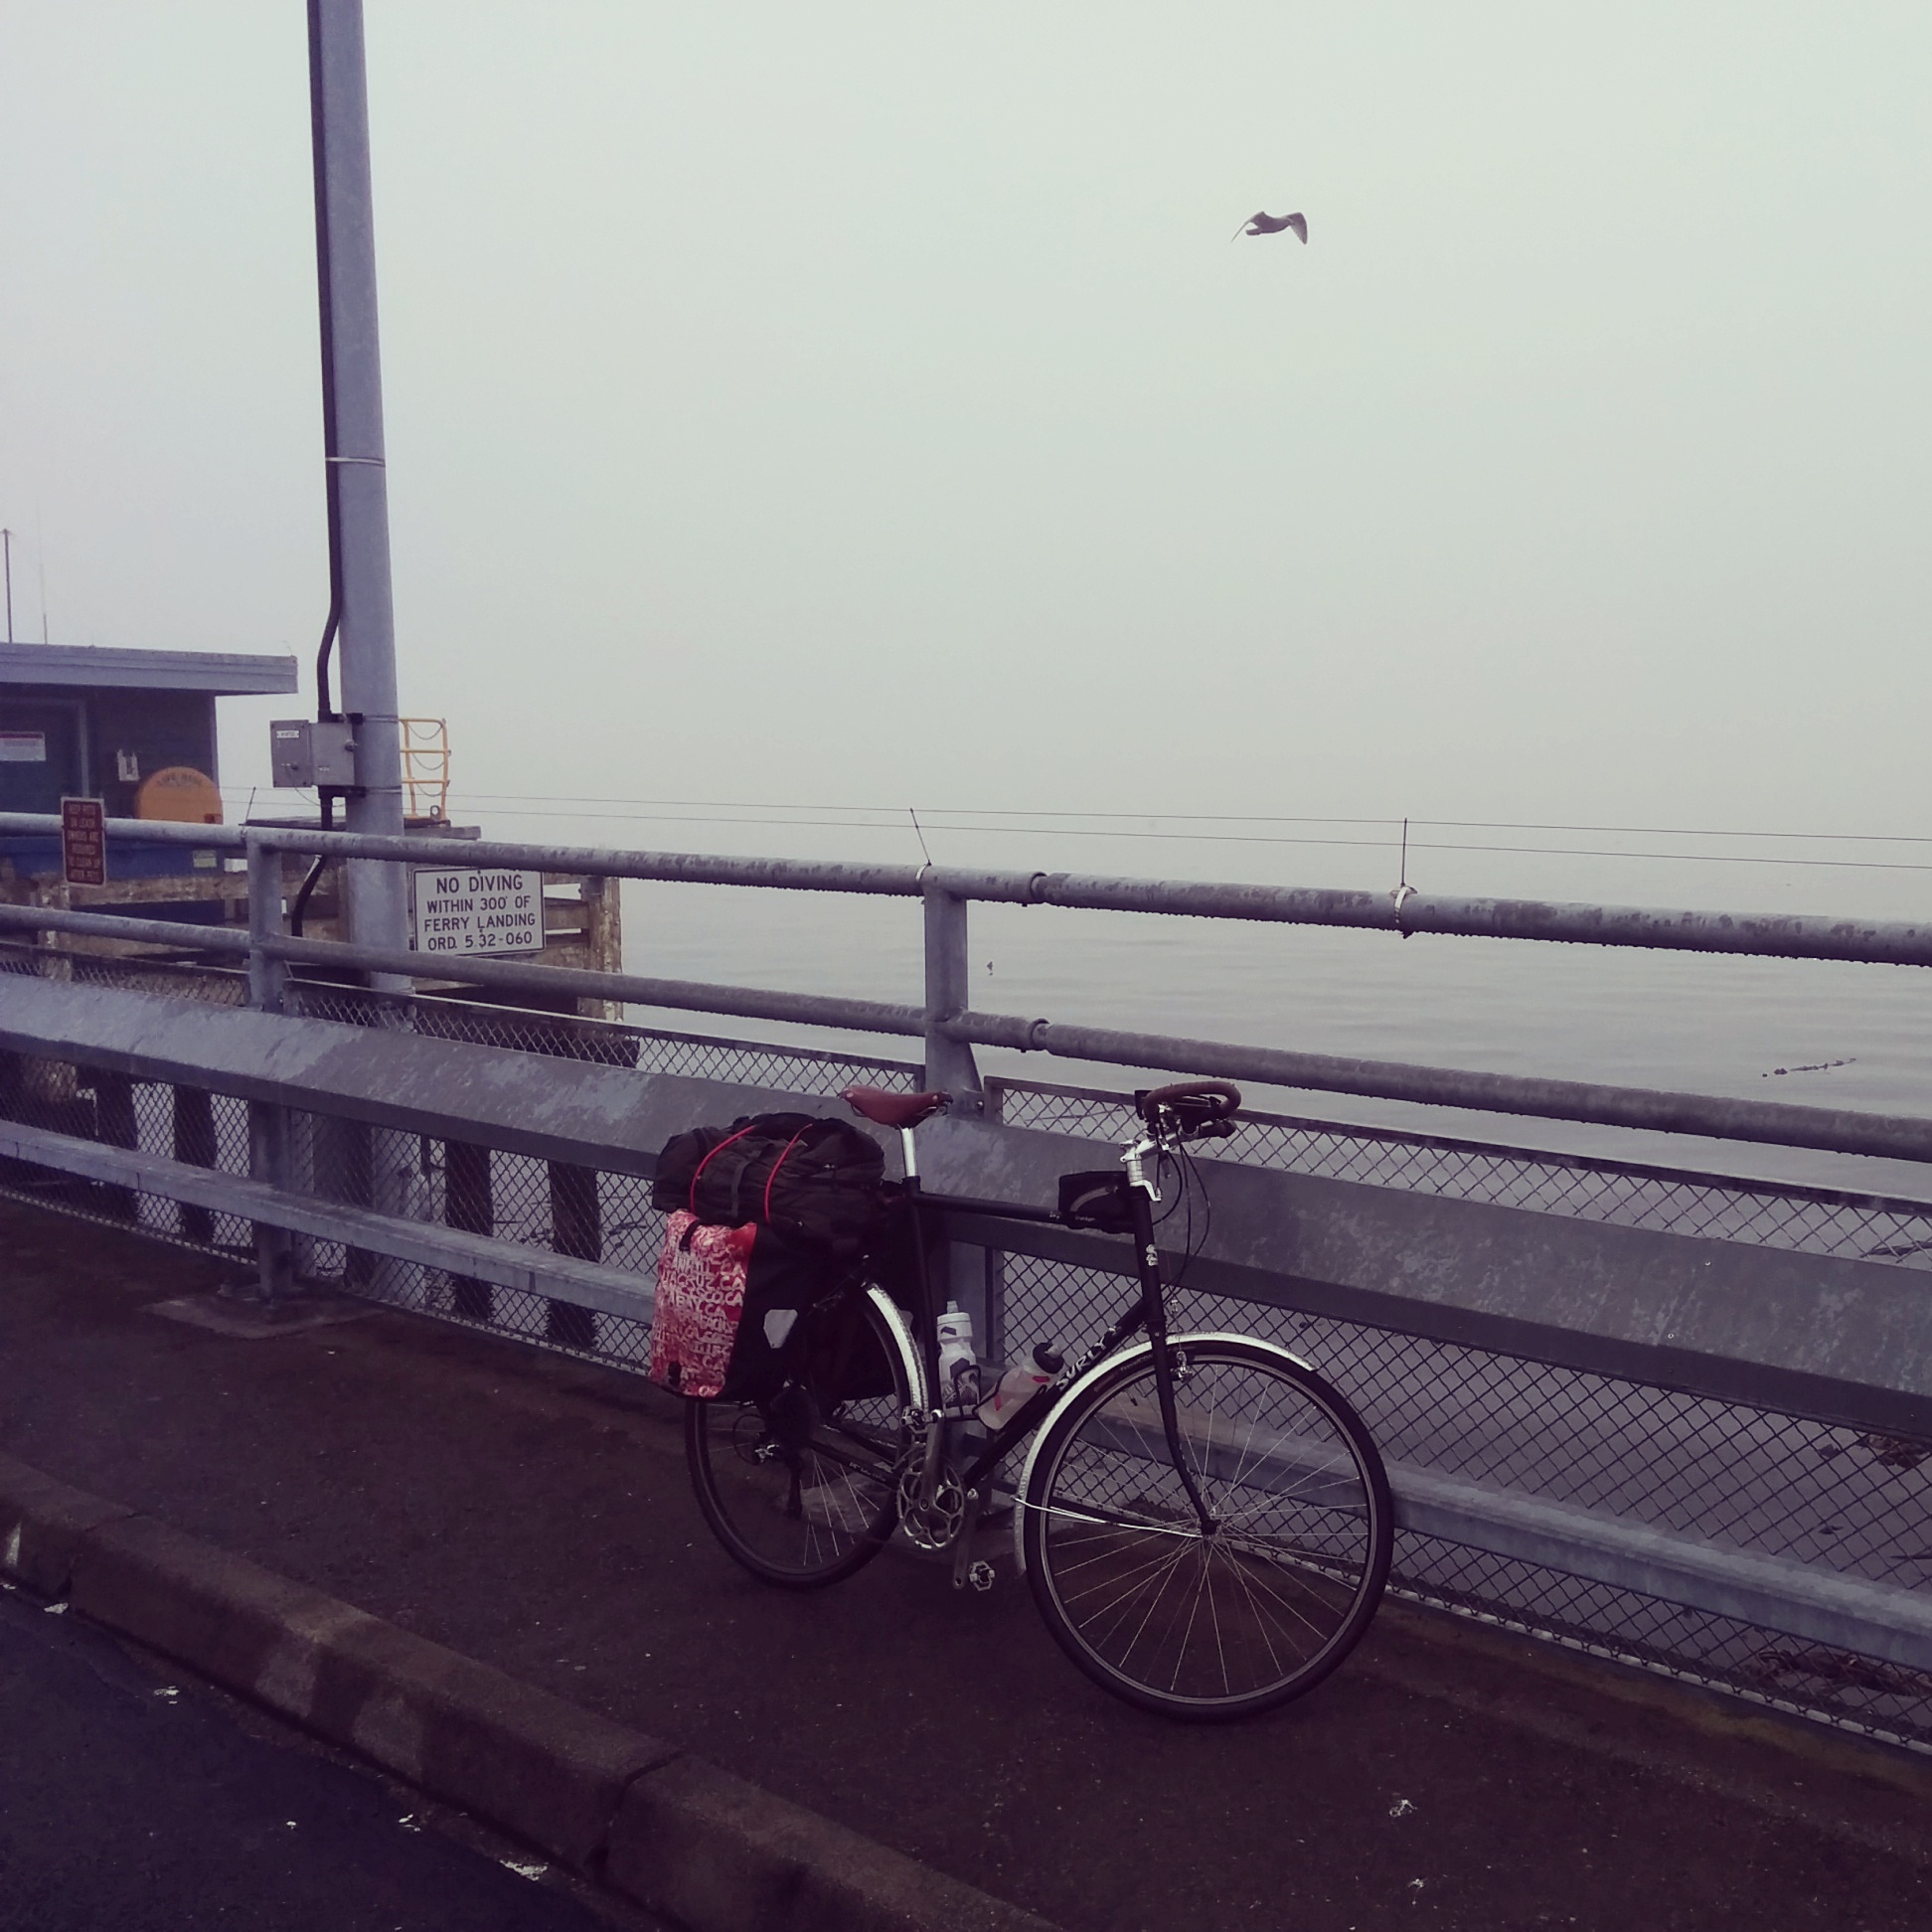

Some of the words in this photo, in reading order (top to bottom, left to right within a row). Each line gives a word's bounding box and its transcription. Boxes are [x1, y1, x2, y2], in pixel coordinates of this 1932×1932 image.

[436, 877, 460, 894] NO
[468, 875, 523, 892] DIVING
[426, 898, 473, 913] WITHIN
[514, 895, 531, 909] OF
[423, 916, 470, 932] FERRY
[477, 912, 536, 929] LANDING
[427, 936, 457, 951] ORD.
[1055, 1335, 1107, 1391] SURLY
